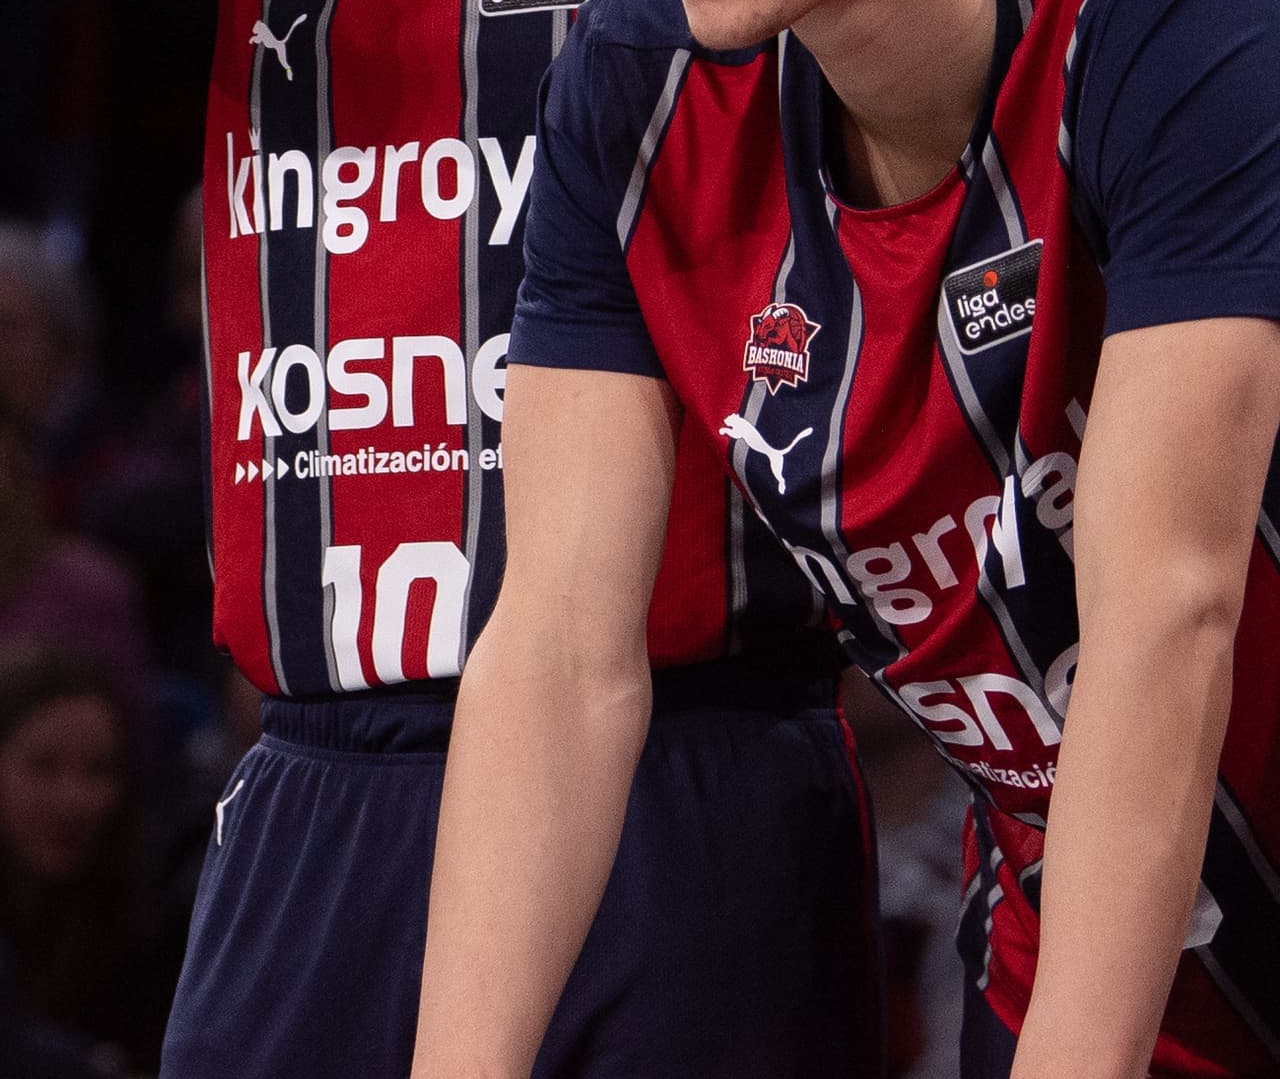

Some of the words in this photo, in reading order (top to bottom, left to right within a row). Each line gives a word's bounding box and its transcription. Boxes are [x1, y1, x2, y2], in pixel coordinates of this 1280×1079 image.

[226, 127, 537, 255] kingroy
[957, 287, 999, 318] liga
[965, 298, 1036, 339] endes
[747, 346, 804, 374] BASKONIA
[294, 442, 470, 480] Climatización
[322, 541, 471, 693] 10
